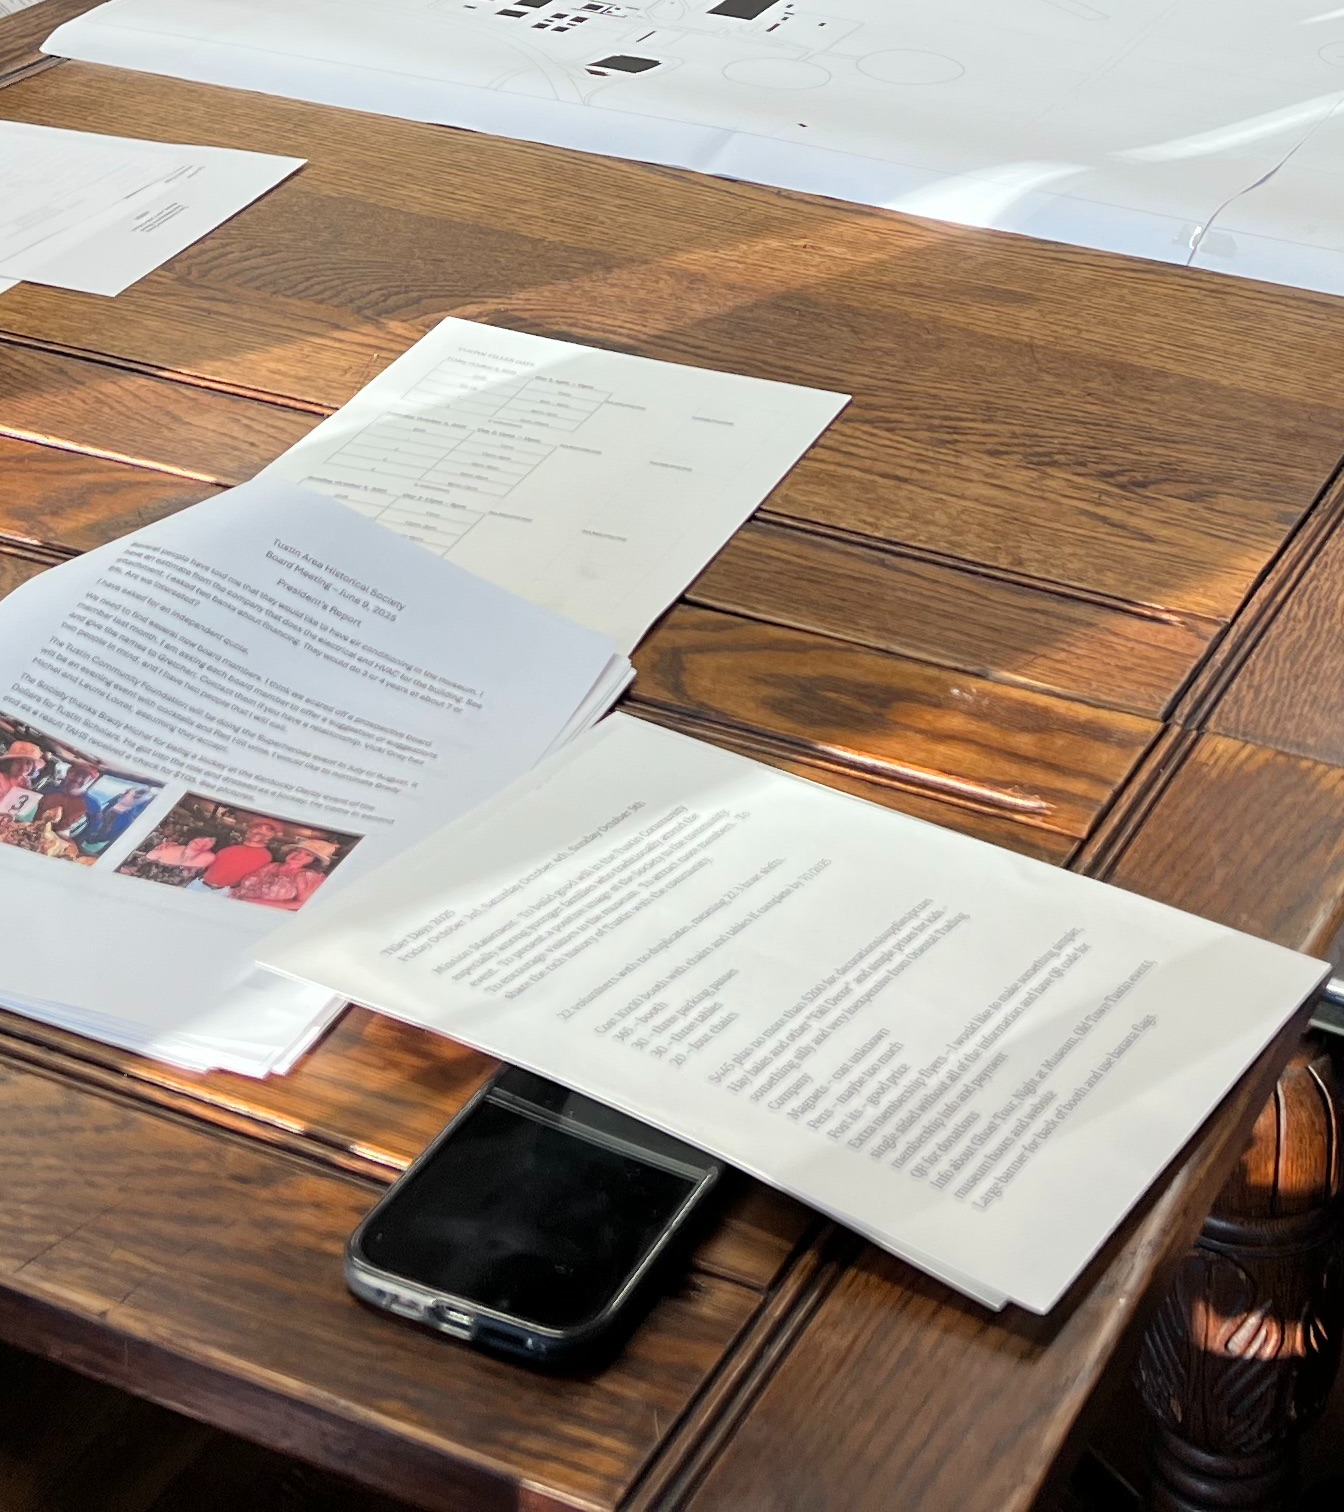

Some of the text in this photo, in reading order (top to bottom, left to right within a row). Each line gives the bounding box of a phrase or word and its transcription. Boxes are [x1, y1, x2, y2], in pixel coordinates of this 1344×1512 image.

[264, 550, 294, 568] Board
[292, 564, 332, 590] Meeting
[338, 588, 362, 604] June
[372, 605, 397, 622] 2025
[272, 538, 405, 610] Tustin Area Historical Society
[276, 578, 362, 627] President's Report
[634, 999, 669, 1024] booth
[649, 1012, 682, 1035] three
[673, 986, 715, 1017] parking
[667, 1020, 700, 1042] three
[691, 1000, 724, 1023] tables
[687, 1031, 714, 1050] four
[705, 1009, 739, 1034] chairs
[726, 1020, 812, 1093] Hay bales and other
[765, 1071, 815, 1112] Company
[785, 1026, 891, 1121] Magnets cost unknown
[806, 1039, 904, 1129] Pens maybe too much
[826, 1061, 912, 1139] Post its good price
[889, 1051, 1009, 1171] membership info and payment
[920, 1148, 943, 1165] for
[933, 1108, 981, 1153] donations
[953, 1088, 1057, 1199] museum hours and website
